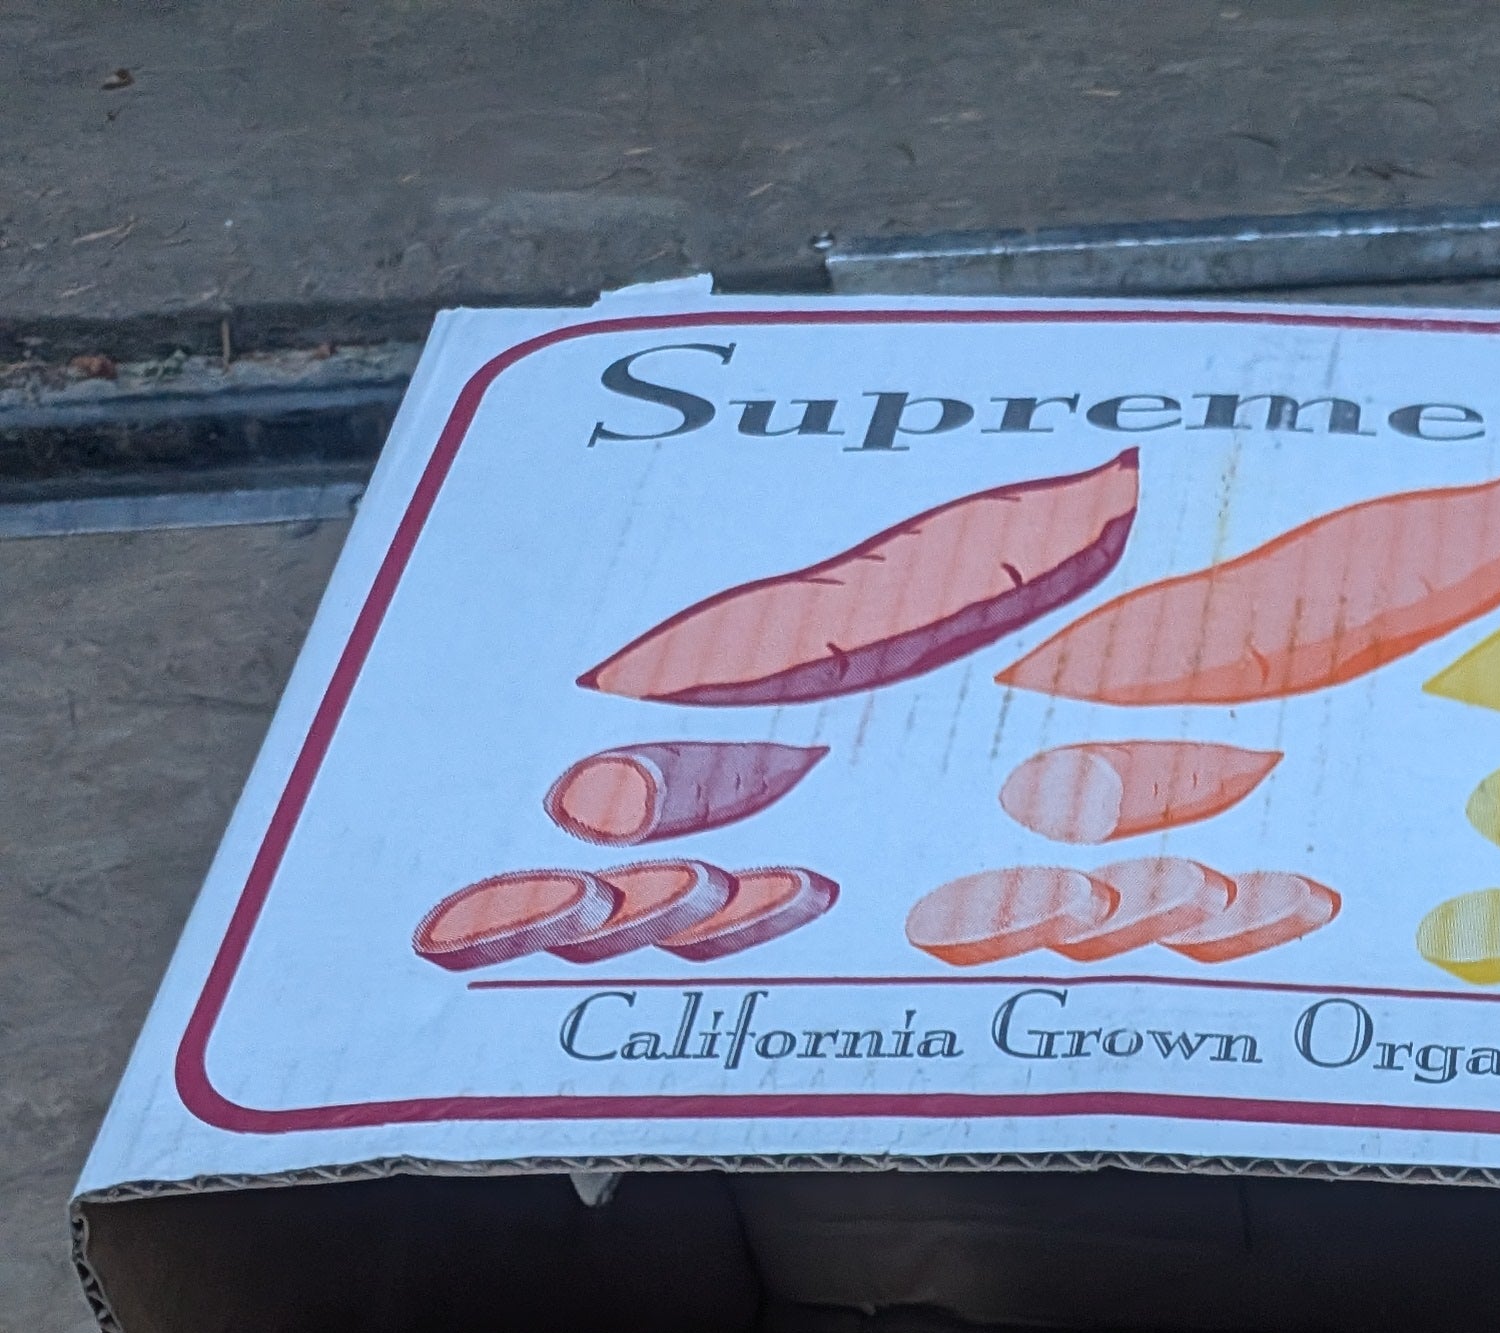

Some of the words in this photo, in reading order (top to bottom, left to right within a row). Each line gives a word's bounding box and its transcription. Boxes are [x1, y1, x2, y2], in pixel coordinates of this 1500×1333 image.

[587, 342, 1485, 452] Supreme
[559, 990, 965, 1070] California
[991, 988, 1264, 1063] Grown
